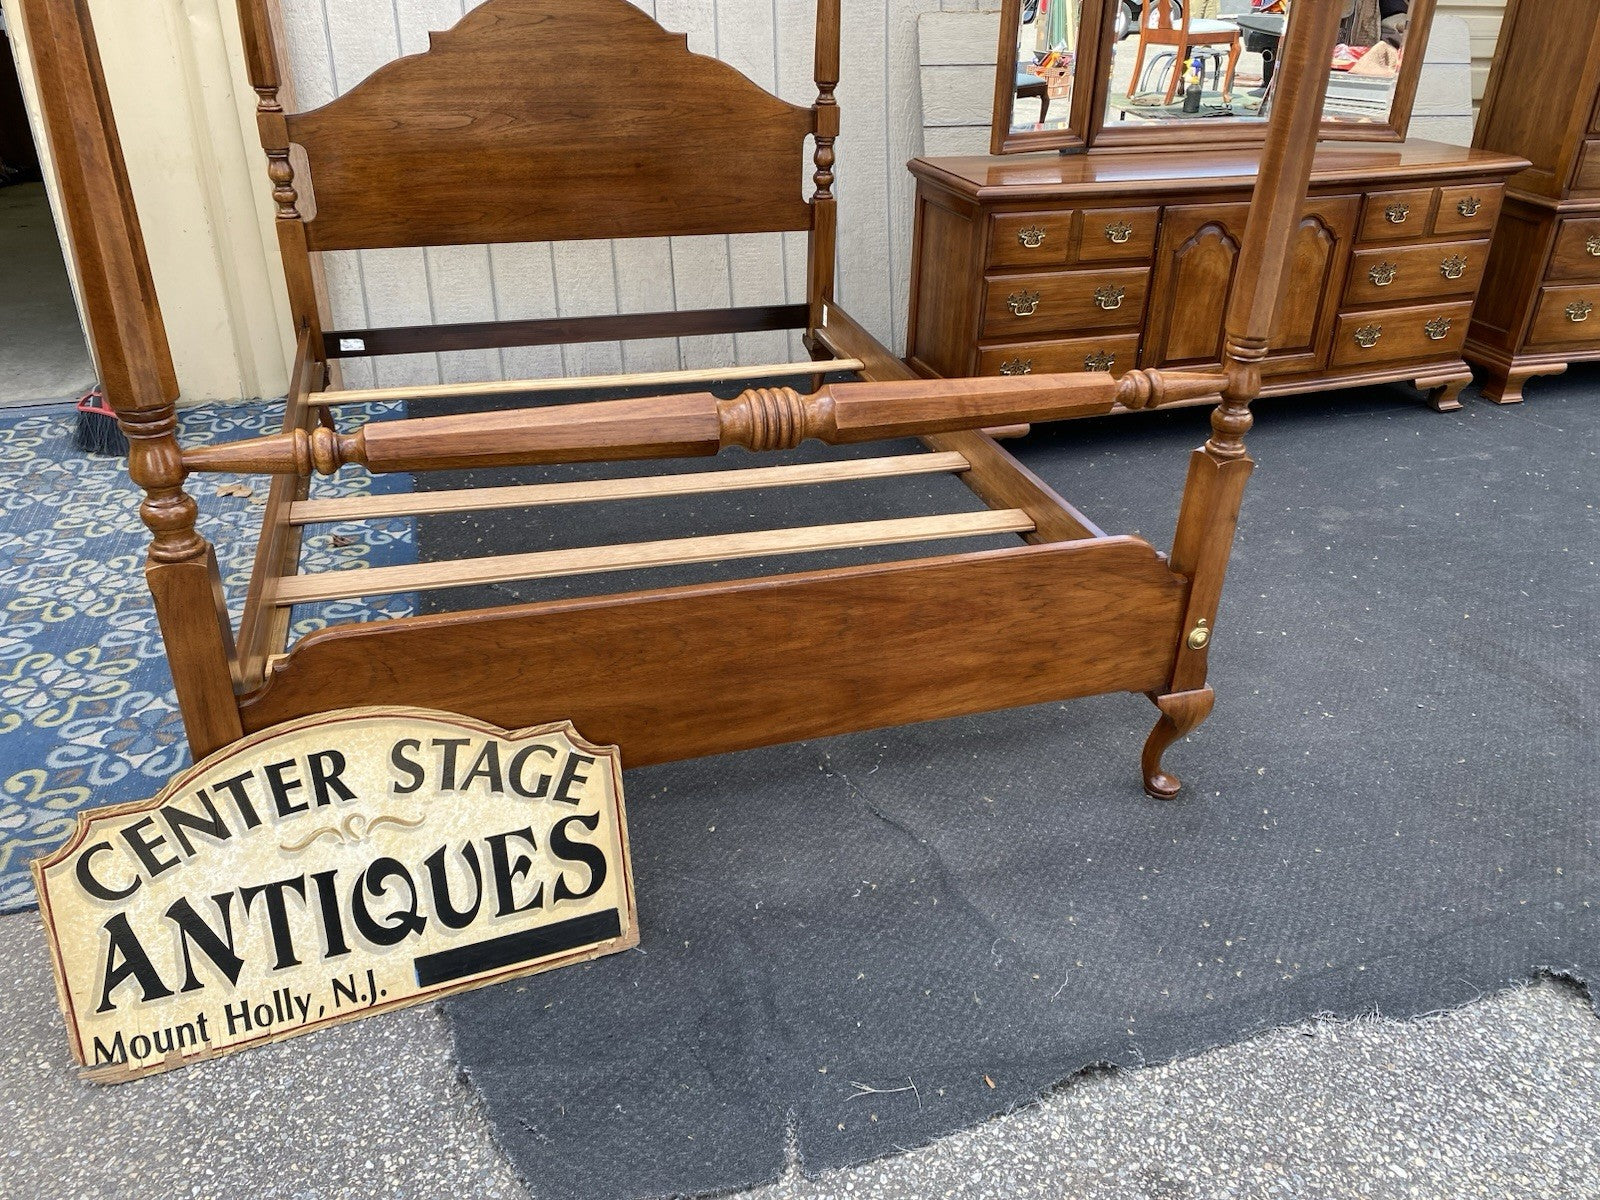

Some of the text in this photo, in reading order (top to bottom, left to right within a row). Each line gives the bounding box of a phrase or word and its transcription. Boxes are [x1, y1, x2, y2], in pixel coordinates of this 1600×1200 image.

[75, 738, 596, 901] CENTER STAGE
[95, 811, 608, 1013] ANTIQUES
[92, 968, 388, 1066] Mount Holly, N.J.
